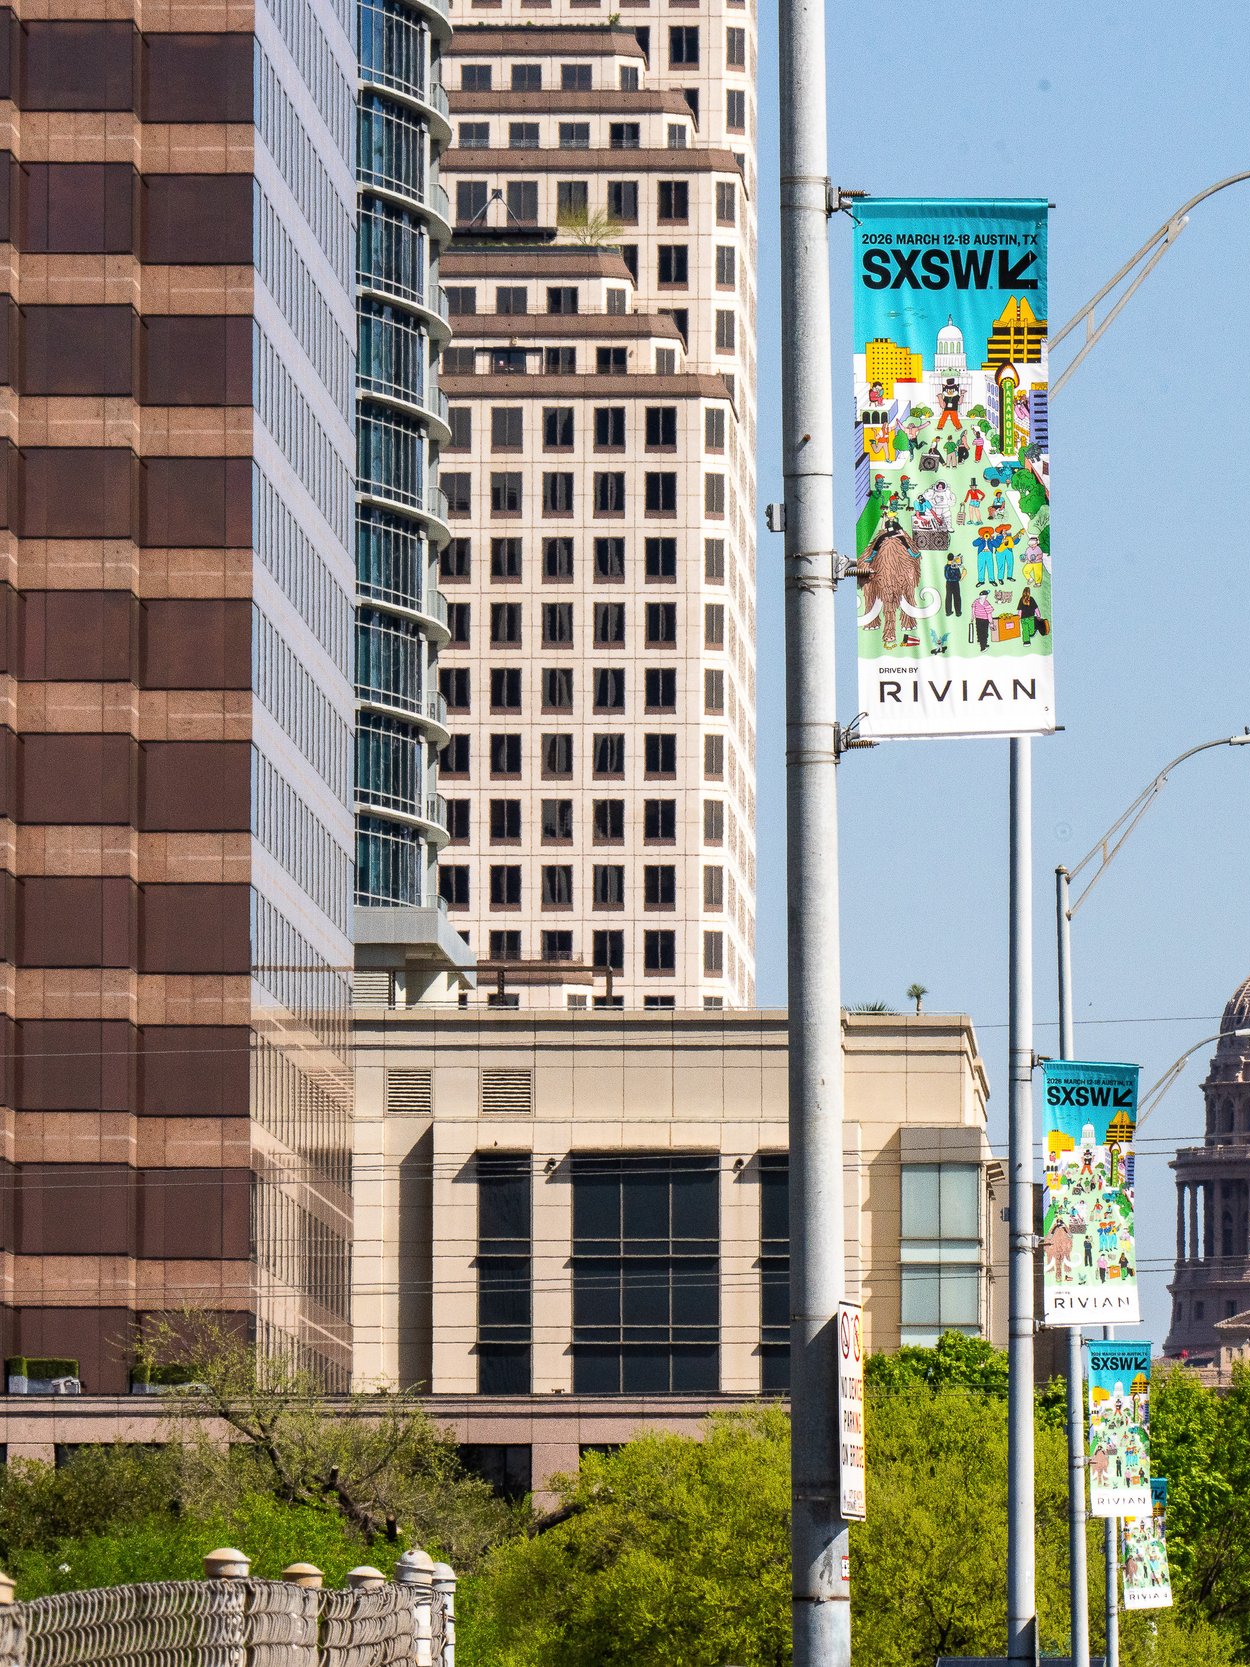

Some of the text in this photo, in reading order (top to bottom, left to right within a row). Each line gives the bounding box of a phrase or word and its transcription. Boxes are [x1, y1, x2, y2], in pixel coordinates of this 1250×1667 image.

[862, 234, 1038, 247] 2026 MARCH 12-18 AUSTIN, TX
[862, 248, 995, 290] SXSW
[879, 678, 1036, 703] RIVIAN
[1047, 1085, 1111, 1107] SXSW
[1054, 1297, 1130, 1309] RIVIAN
[1091, 1356, 1133, 1371] SXSW
[1097, 1497, 1146, 1505] RIVIAN
